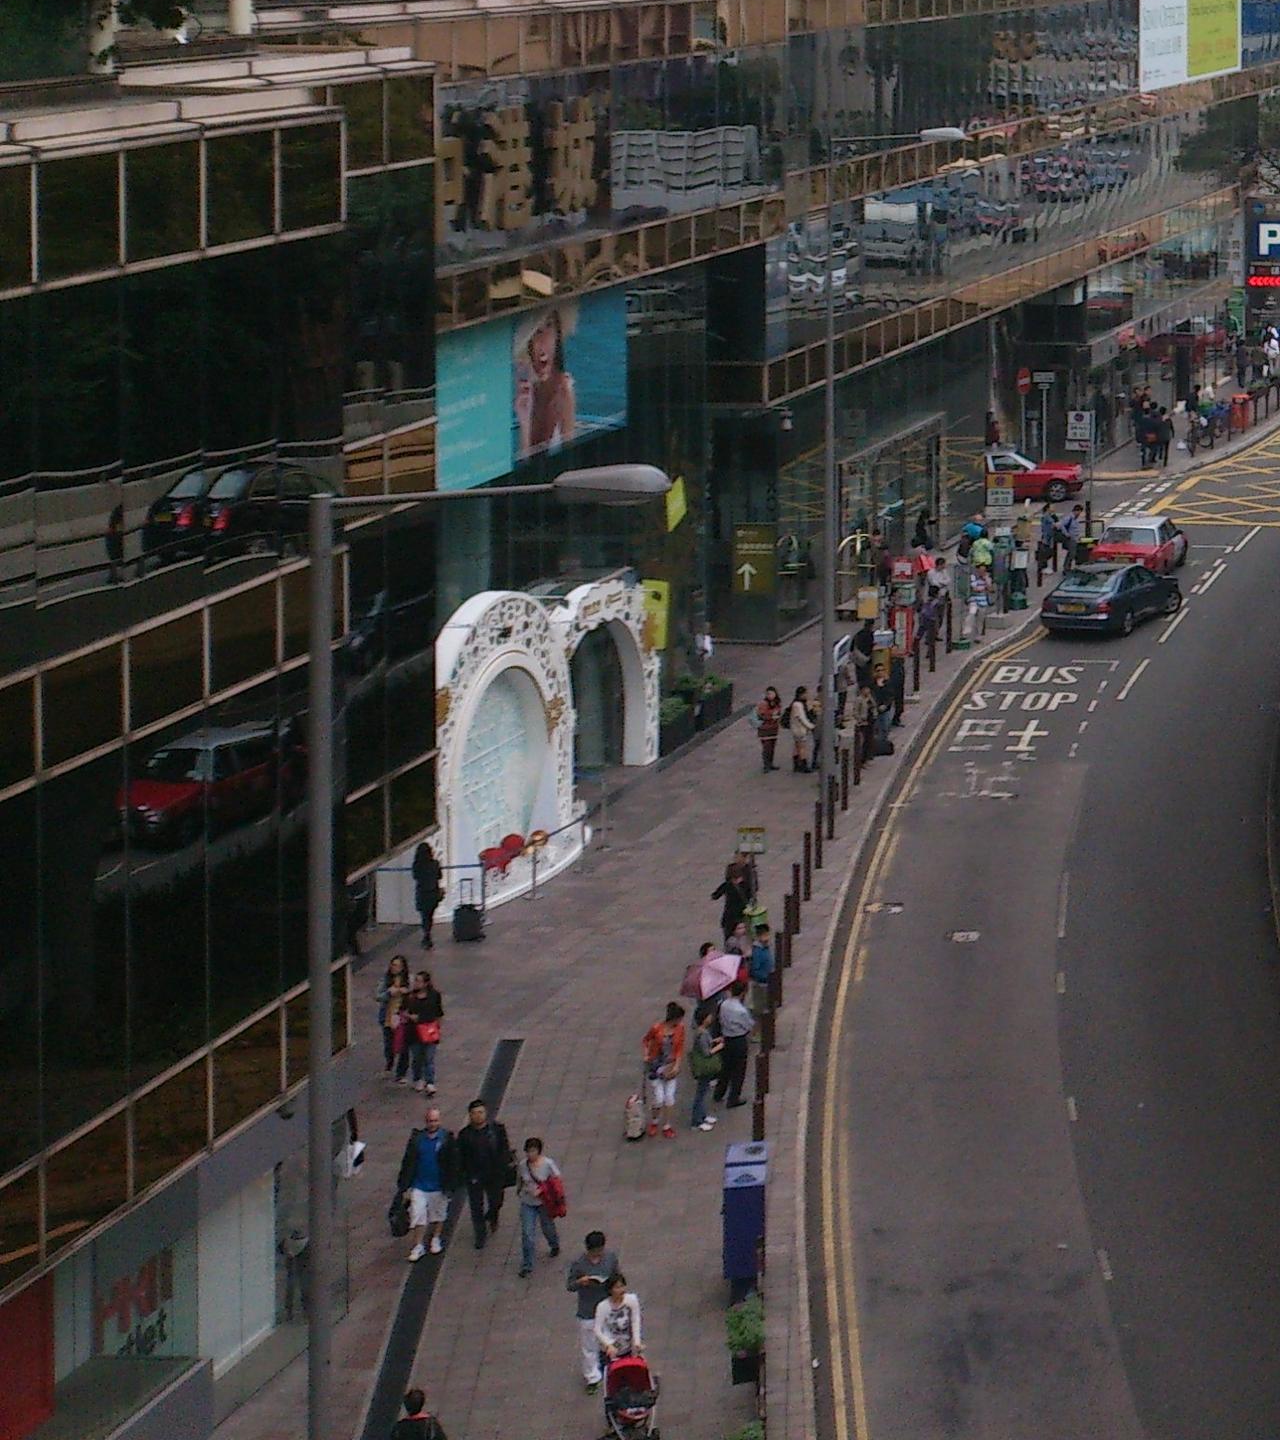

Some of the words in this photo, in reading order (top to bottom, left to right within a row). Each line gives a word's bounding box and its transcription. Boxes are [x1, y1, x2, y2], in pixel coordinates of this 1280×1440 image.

[991, 666, 1084, 683] BUS
[963, 691, 1078, 710] STOP
[947, 719, 1050, 752] 巴士
